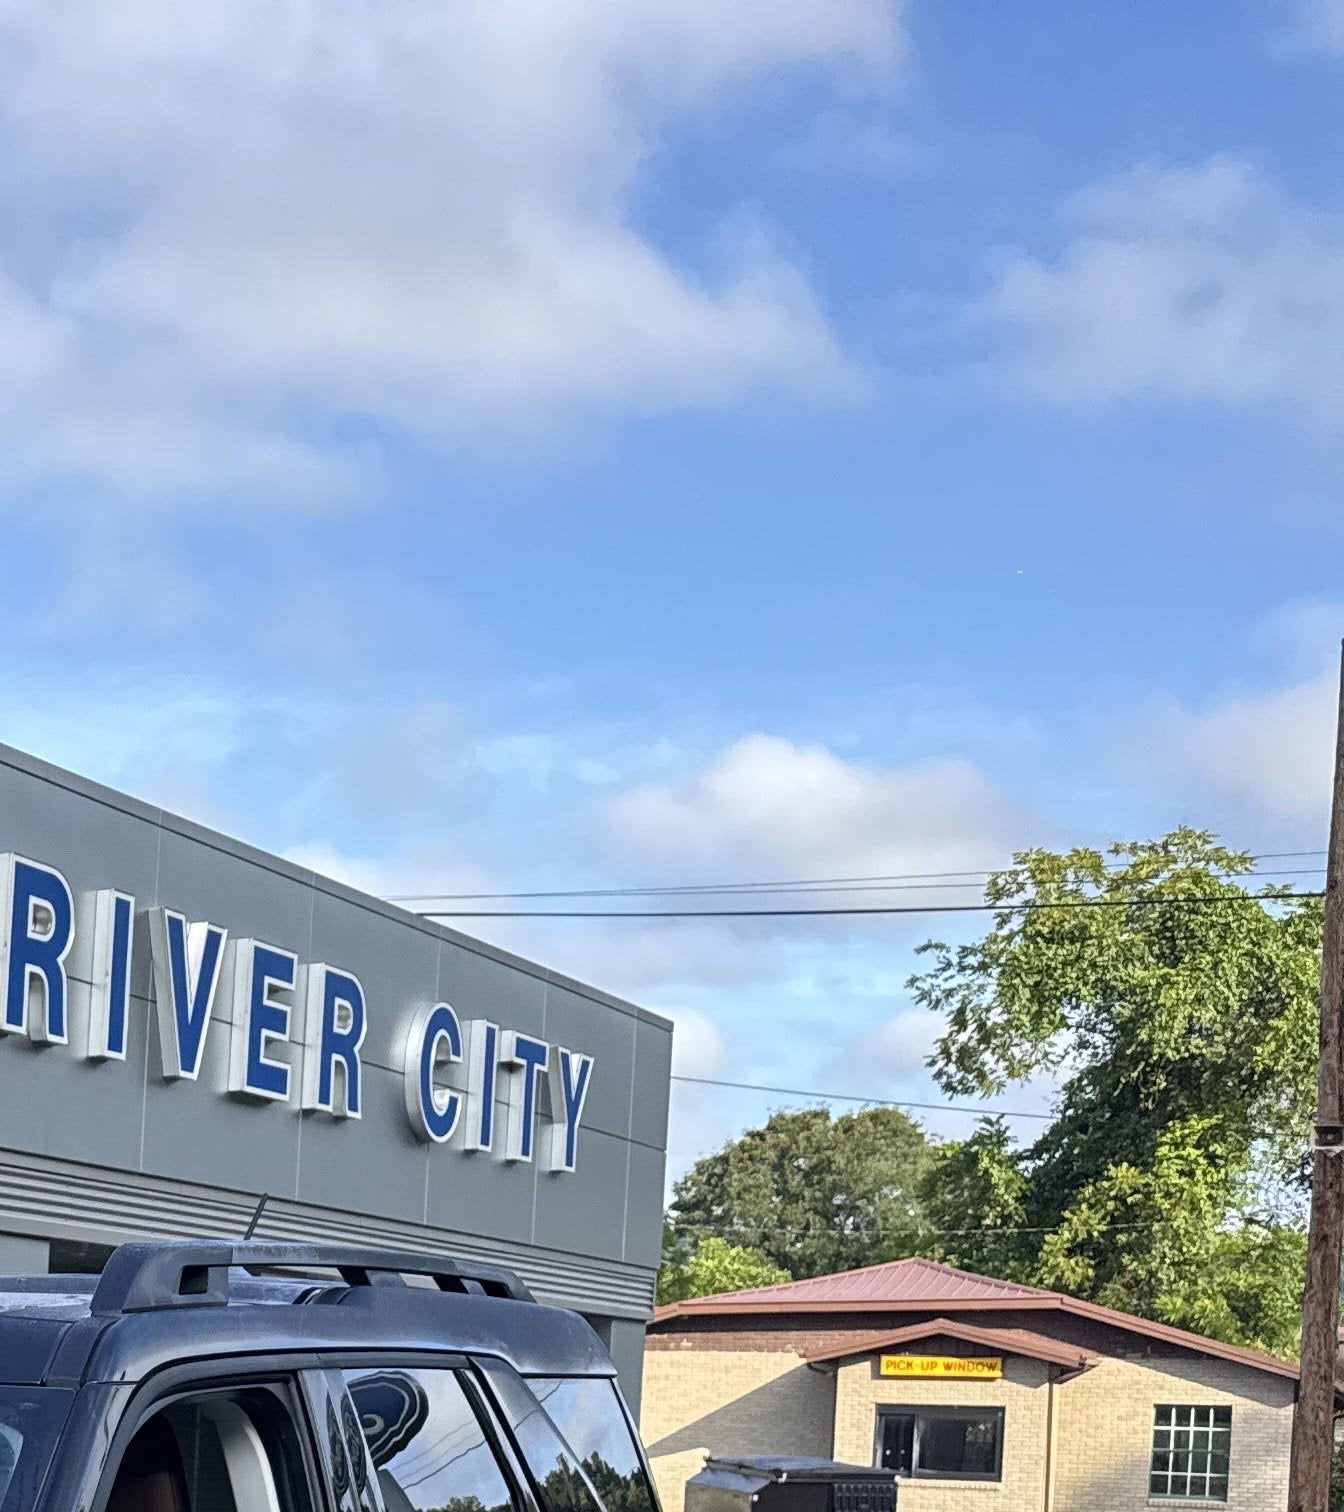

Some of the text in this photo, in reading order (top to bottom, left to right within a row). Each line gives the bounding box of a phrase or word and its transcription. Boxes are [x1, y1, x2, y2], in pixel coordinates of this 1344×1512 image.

[404, 1002, 594, 1173] CITY
[885, 1359, 998, 1373] PICK-UP WINDOW
